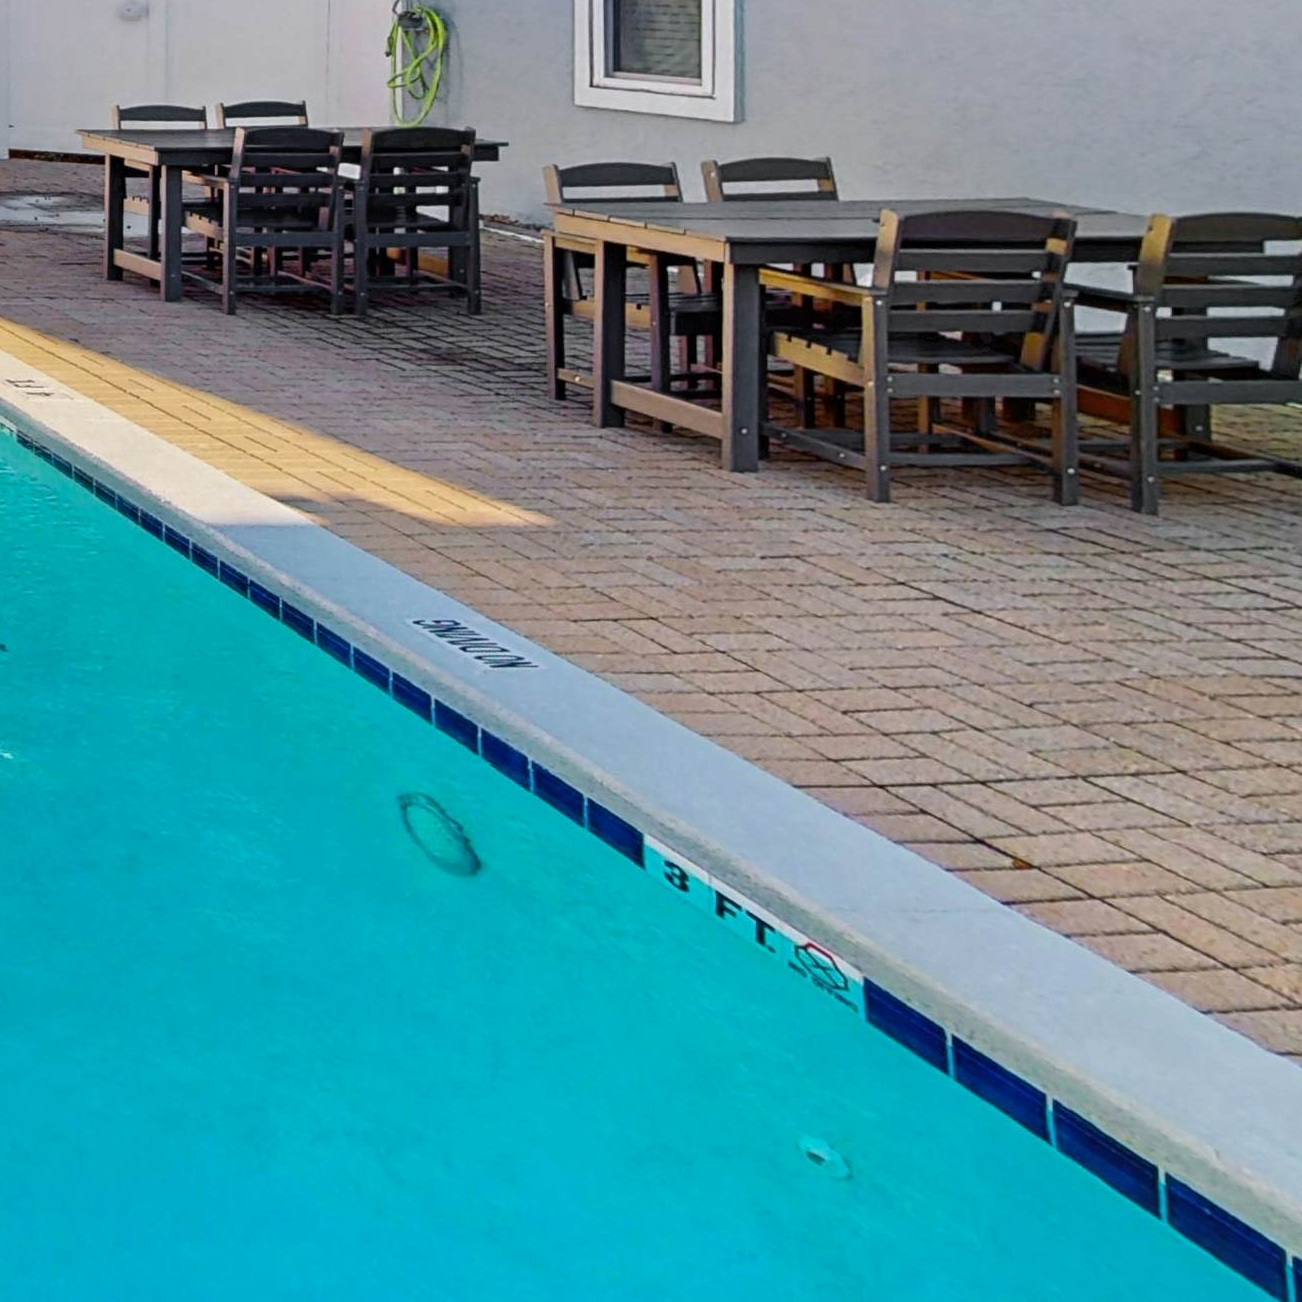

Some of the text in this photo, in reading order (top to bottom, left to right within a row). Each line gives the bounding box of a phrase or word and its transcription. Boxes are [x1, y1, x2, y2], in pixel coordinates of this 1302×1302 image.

[412, 618, 540, 669] NO DIVING
[663, 859, 690, 893] 3
